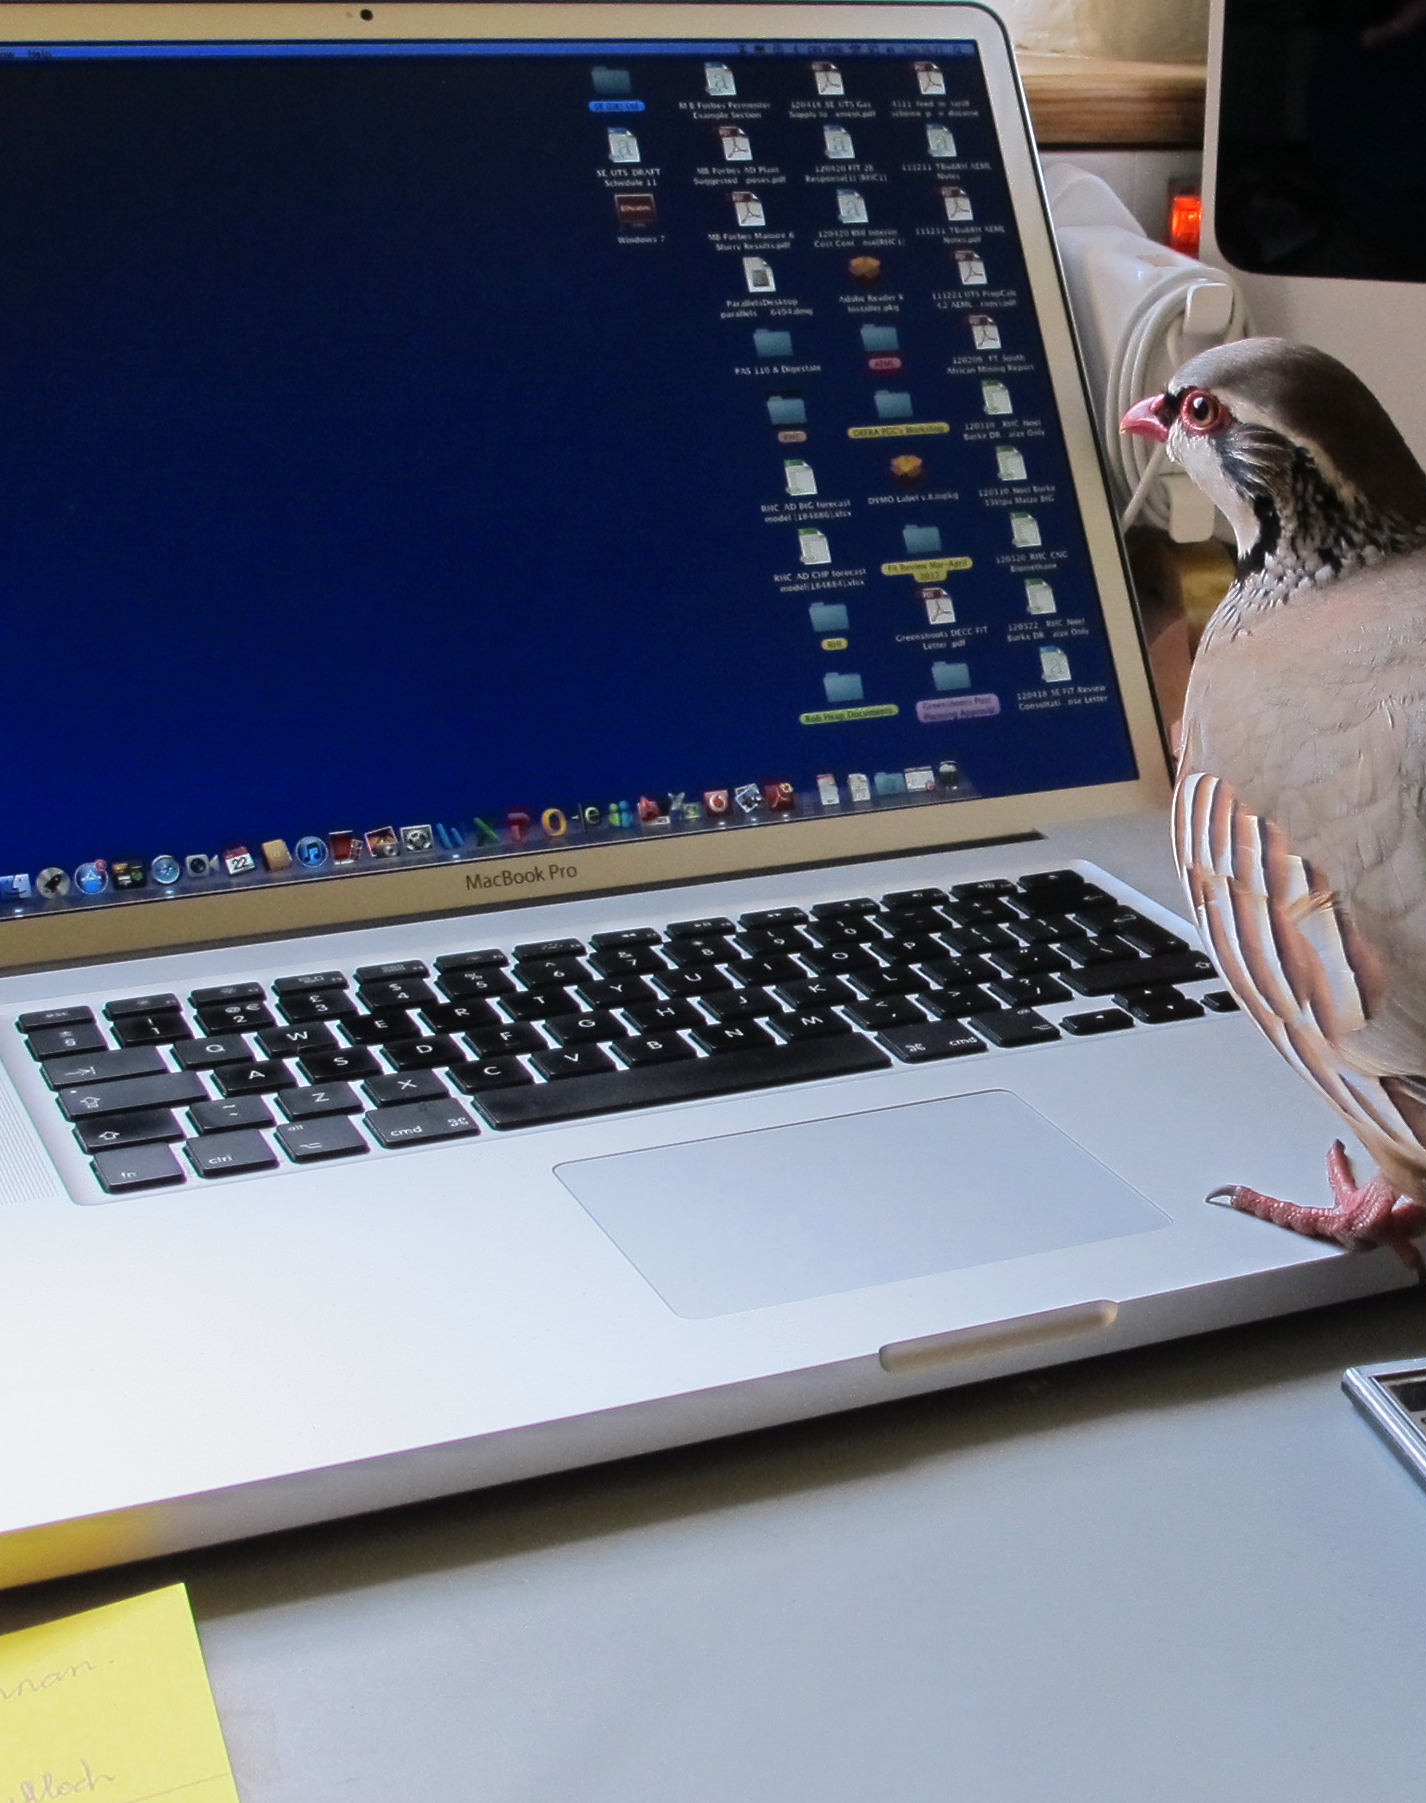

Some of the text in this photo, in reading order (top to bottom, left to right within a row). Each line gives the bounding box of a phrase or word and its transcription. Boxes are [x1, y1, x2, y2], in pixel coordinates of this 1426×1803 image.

[604, 178, 643, 187] Schedule
[617, 236, 658, 244] Windows
[816, 500, 851, 508] forecast
[868, 494, 919, 505] DYMO Label
[764, 514, 792, 523] model
[1050, 550, 1069, 558] CNG
[831, 568, 867, 577] forecast
[1010, 563, 1057, 573] Biomethane
[895, 628, 974, 642] Greenshoots DECC
[922, 642, 947, 650] Letter
[1077, 684, 1106, 694] Review
[1084, 695, 1108, 704] Letter
[231, 856, 248, 870] 22
[465, 864, 578, 891] MacBook Pro
[903, 942, 916, 950] P
[832, 952, 849, 960] O
[626, 958, 638, 967] 7
[553, 970, 566, 979] 6
[684, 973, 703, 982] U
[882, 973, 898, 982] L
[476, 981, 489, 990] 5
[608, 984, 623, 994] Y
[808, 984, 827, 994] K
[397, 992, 410, 1000] 4
[533, 996, 547, 1005] T
[316, 1004, 329, 1012] 3
[454, 1008, 470, 1018] R
[656, 1006, 676, 1018] H
[233, 1014, 247, 1024] 2
[578, 1018, 596, 1029] G
[800, 1015, 824, 1026] M
[374, 1020, 389, 1030] E
[286, 1031, 308, 1042] W
[500, 1031, 513, 1042] F
[724, 1028, 744, 1038] N
[646, 1040, 664, 1050] B
[948, 1036, 978, 1048] cmd
[205, 1043, 226, 1054] Q
[416, 1044, 434, 1054] D
[333, 1057, 350, 1066] S
[564, 1053, 580, 1064] V
[248, 1070, 266, 1080] A
[483, 1066, 502, 1076] C
[397, 1079, 418, 1091] X
[311, 1092, 330, 1103] Z
[288, 1124, 304, 1132] alt
[390, 1125, 422, 1137] cmd
[208, 1154, 234, 1164] ctrl
[120, 1170, 138, 1179] fn
